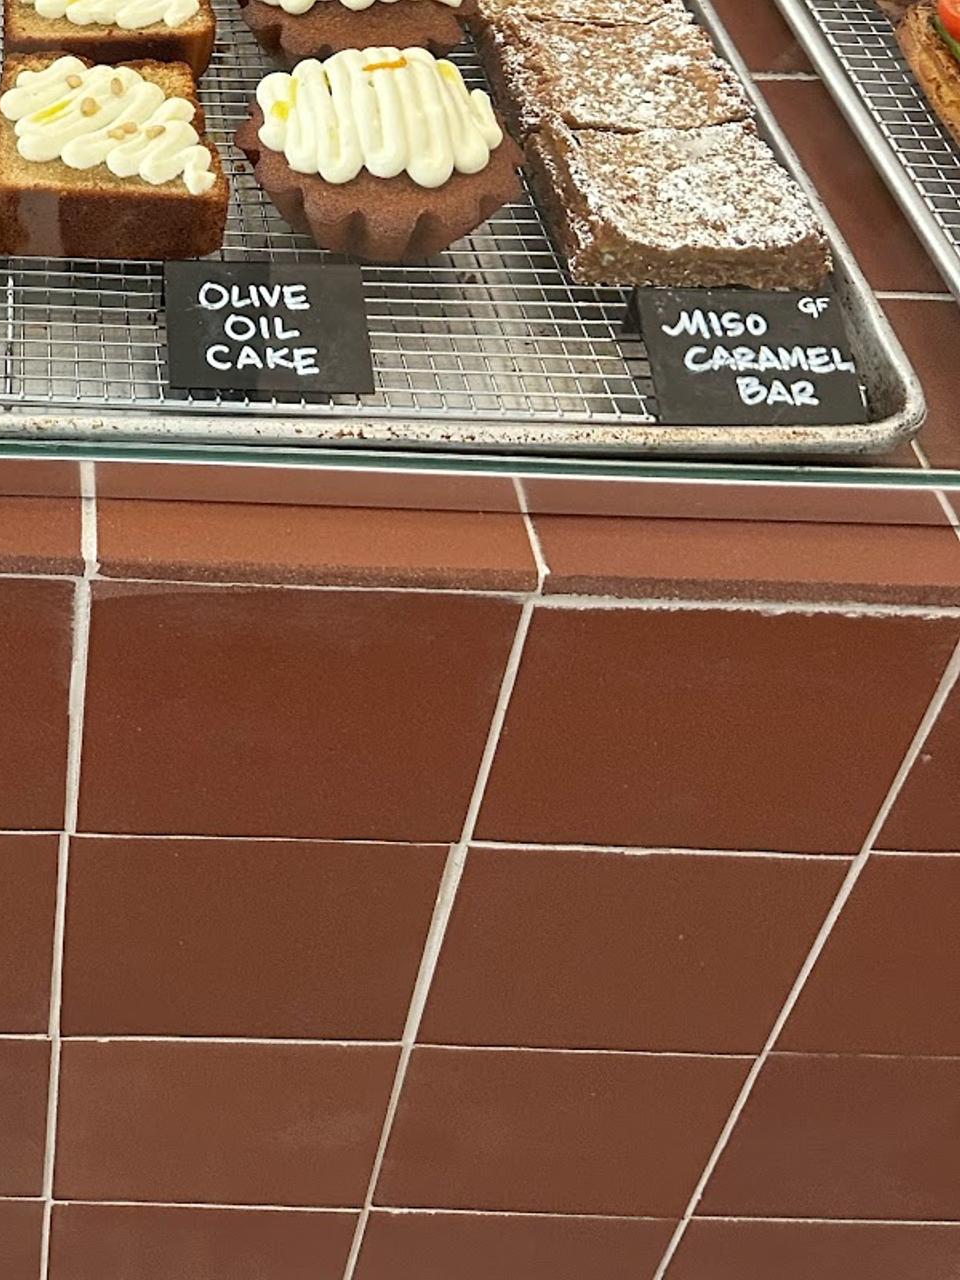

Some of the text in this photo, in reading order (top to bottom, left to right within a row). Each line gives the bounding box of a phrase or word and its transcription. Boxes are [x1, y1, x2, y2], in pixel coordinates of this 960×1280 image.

[198, 281, 311, 311] OLIVE
[797, 297, 830, 319] GF
[224, 313, 300, 342] OIL
[660, 308, 768, 340] MISO
[206, 344, 320, 376] CAKE
[684, 345, 856, 375] CARAMEL
[736, 375, 820, 407] BAR
